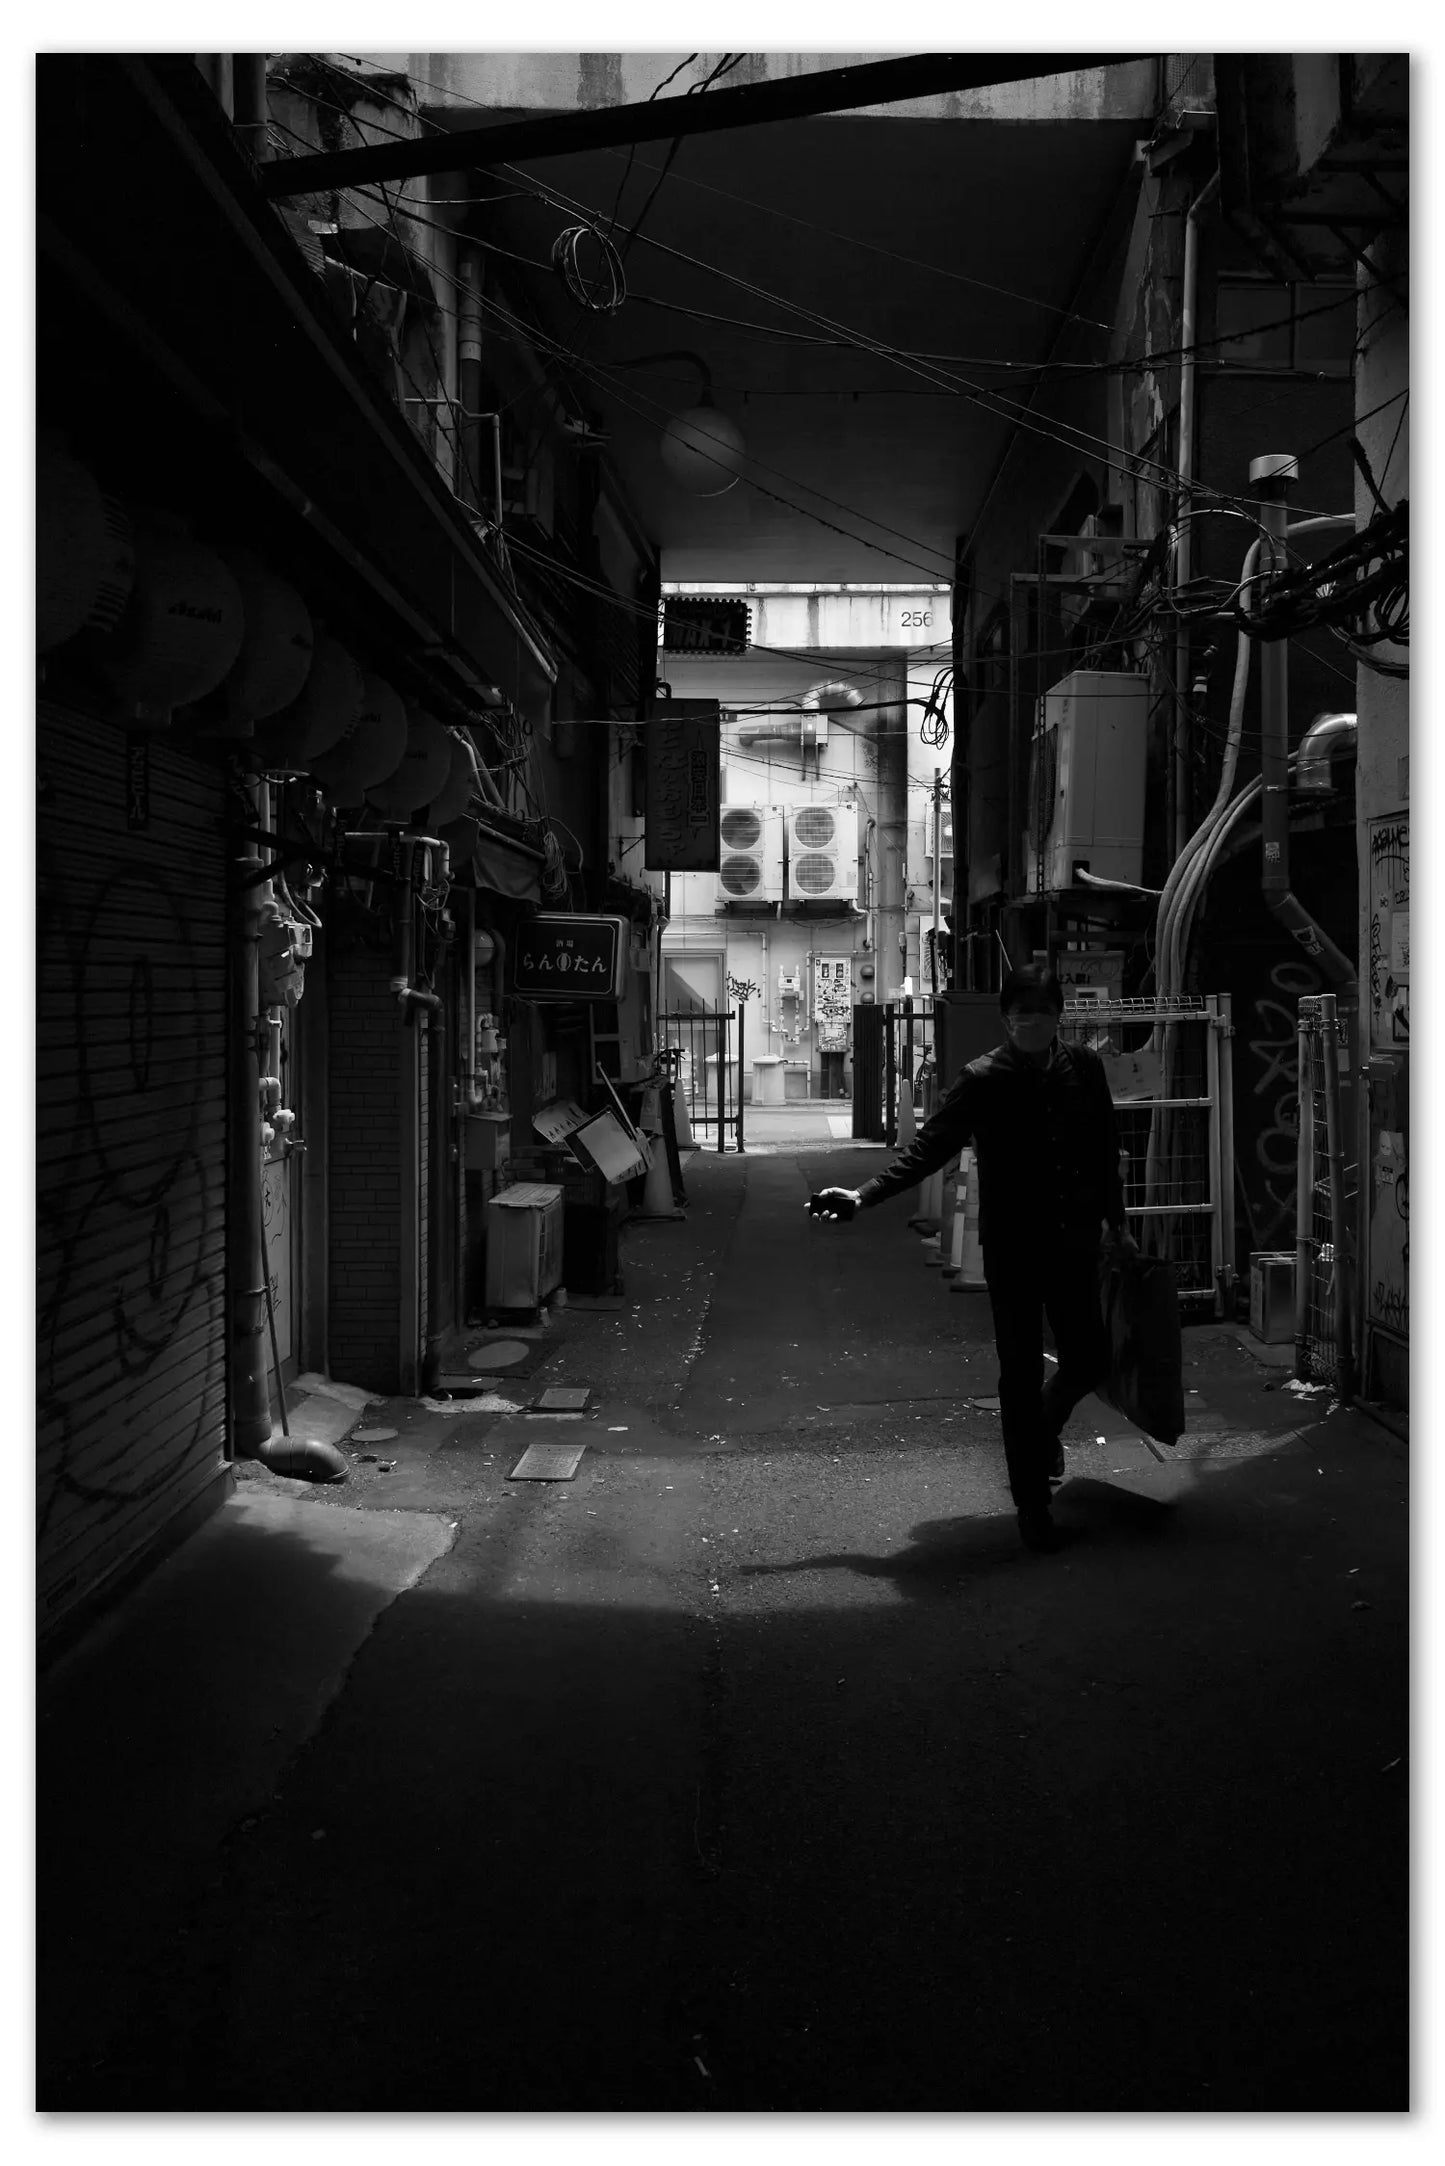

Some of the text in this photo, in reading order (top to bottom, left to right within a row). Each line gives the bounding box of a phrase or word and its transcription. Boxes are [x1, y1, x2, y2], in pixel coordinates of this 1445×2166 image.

[901, 611, 934, 627] 256
[522, 952, 607, 973] らんたん
